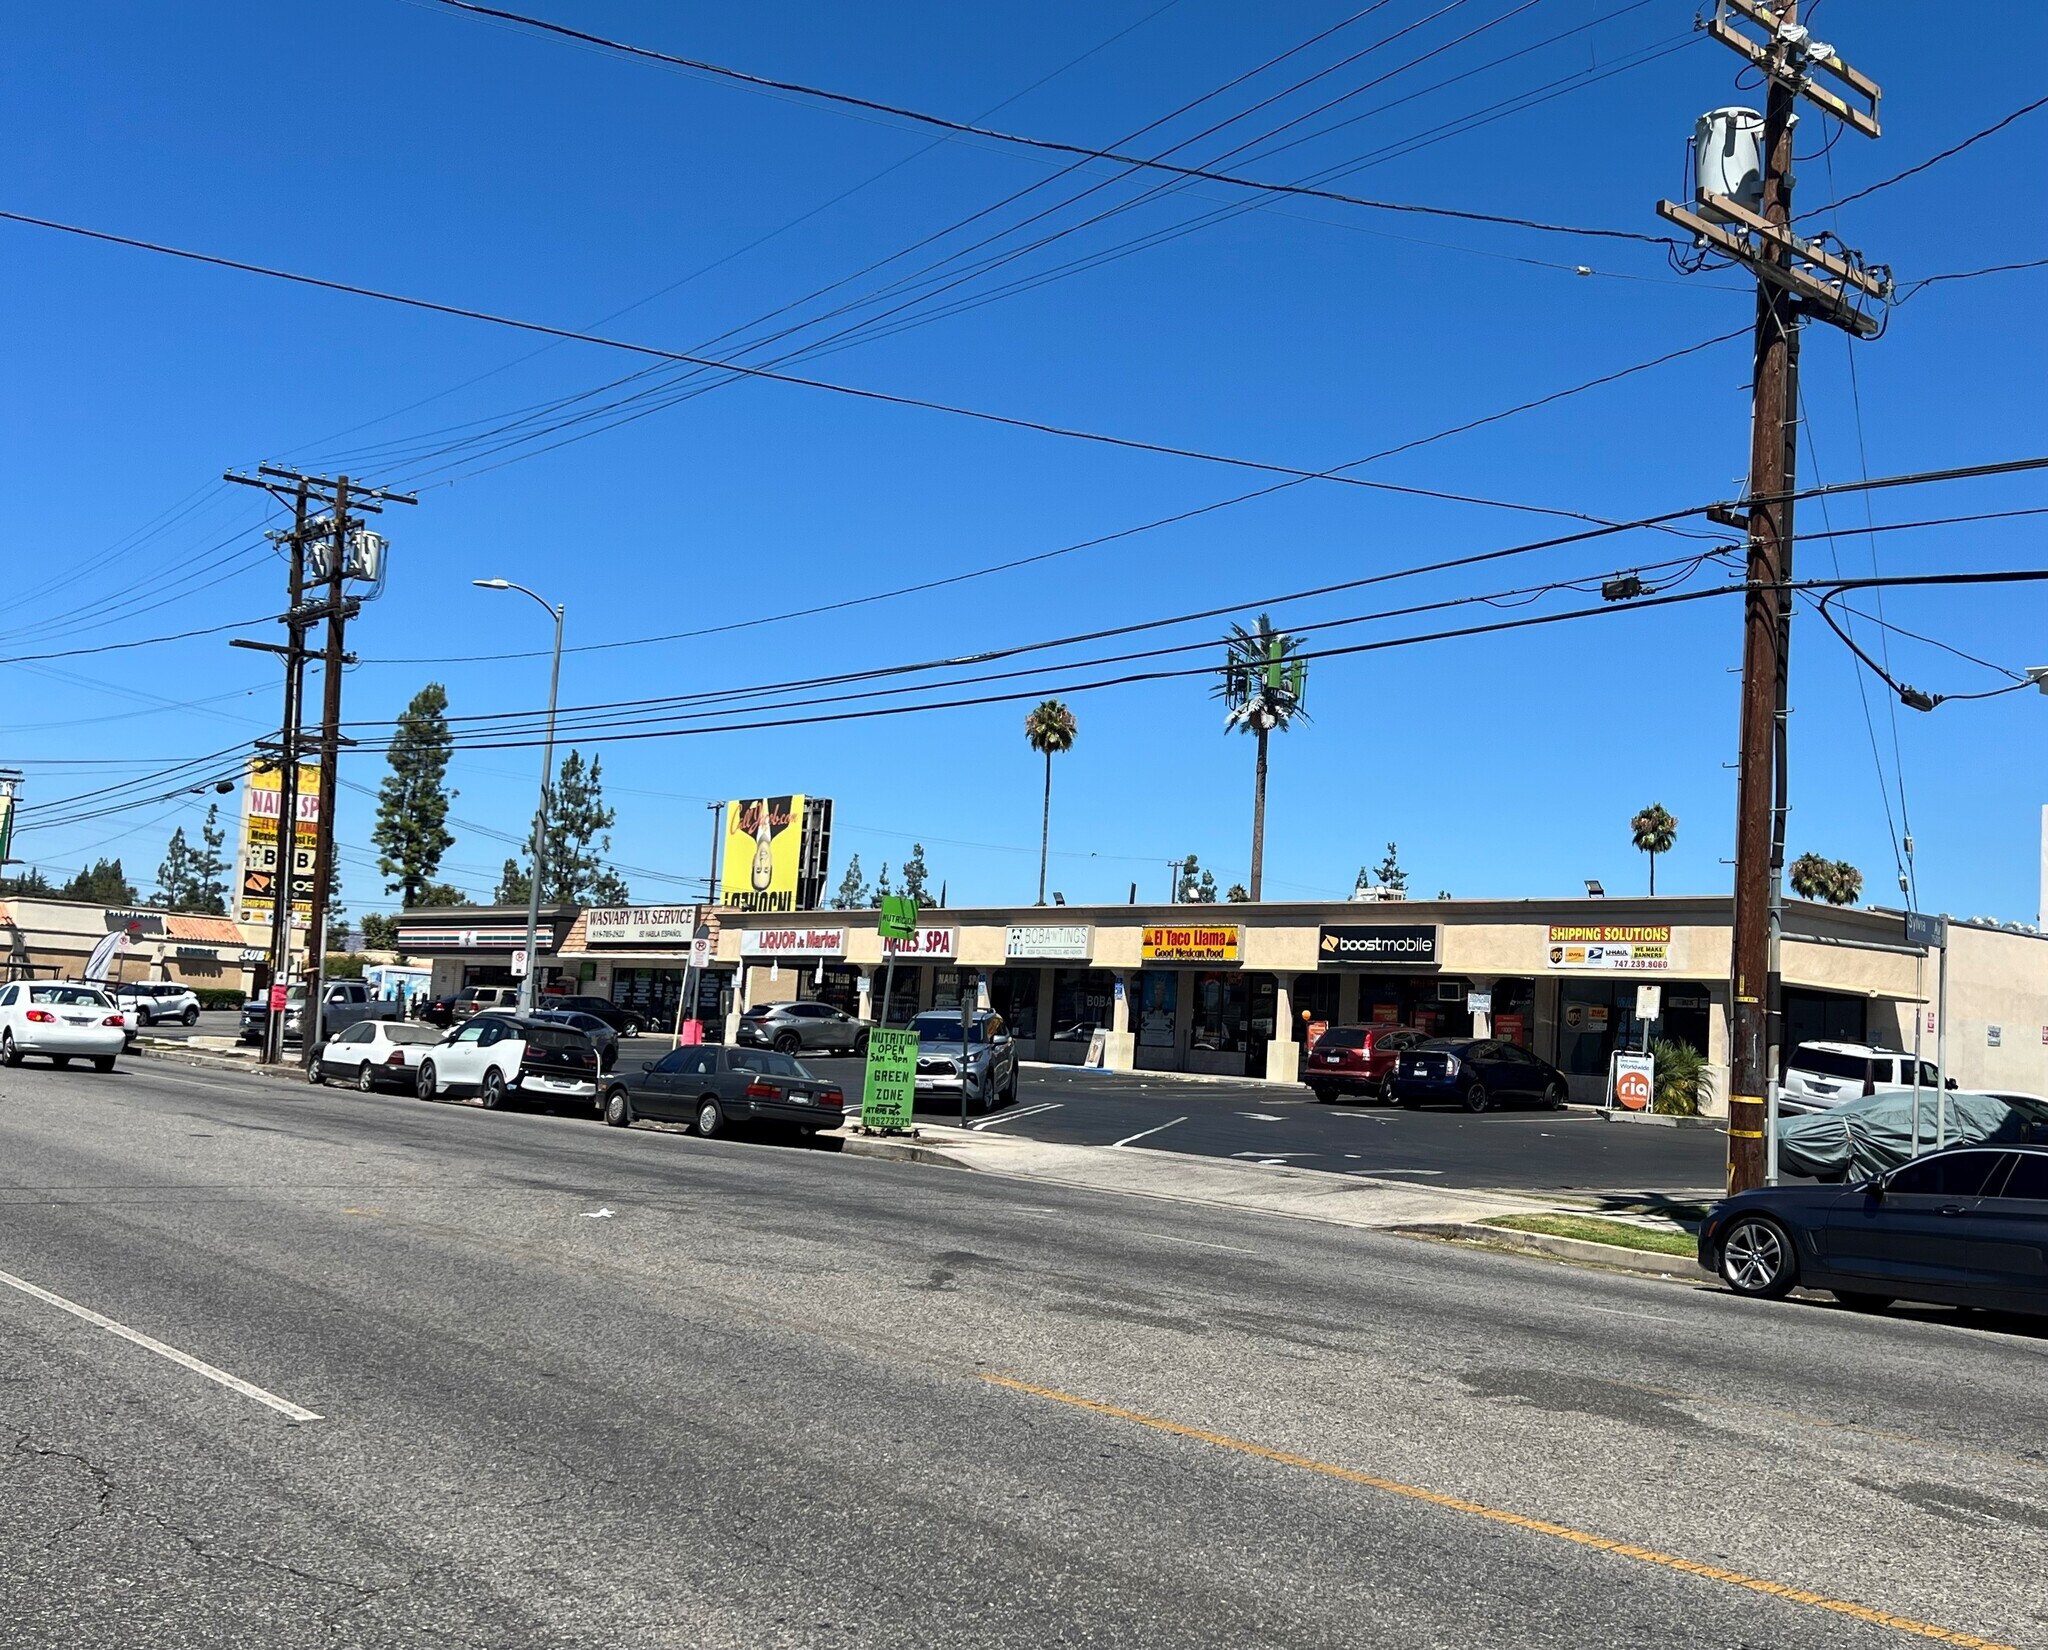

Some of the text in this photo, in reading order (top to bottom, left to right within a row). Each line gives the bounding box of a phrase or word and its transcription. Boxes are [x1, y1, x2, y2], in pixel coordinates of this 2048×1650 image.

[301, 796, 320, 818] SP
[590, 908, 693, 925] WASVARY TAX SERVICE
[759, 931, 797, 949] LIQUOR
[806, 931, 840, 948] Market
[1154, 930, 1226, 946] El Taco Llama
[1551, 927, 1668, 941] SHIPPING SOLUTIONS
[926, 931, 949, 952] SPA
[1155, 948, 1224, 958] Good Mexican Food
[1614, 960, 1668, 968] 747.239.8060
[939, 973, 959, 985] NAILS
[1086, 995, 1113, 1008] BOBA
[872, 1032, 919, 1046] NUTRITION
[878, 1044, 905, 1055] OPEN
[870, 1053, 885, 1063] 5AM
[1620, 1063, 1650, 1071] Worldwide
[874, 1070, 909, 1083] GREEN
[1621, 1076, 1648, 1096] ria
[876, 1089, 904, 1101] ZONE
